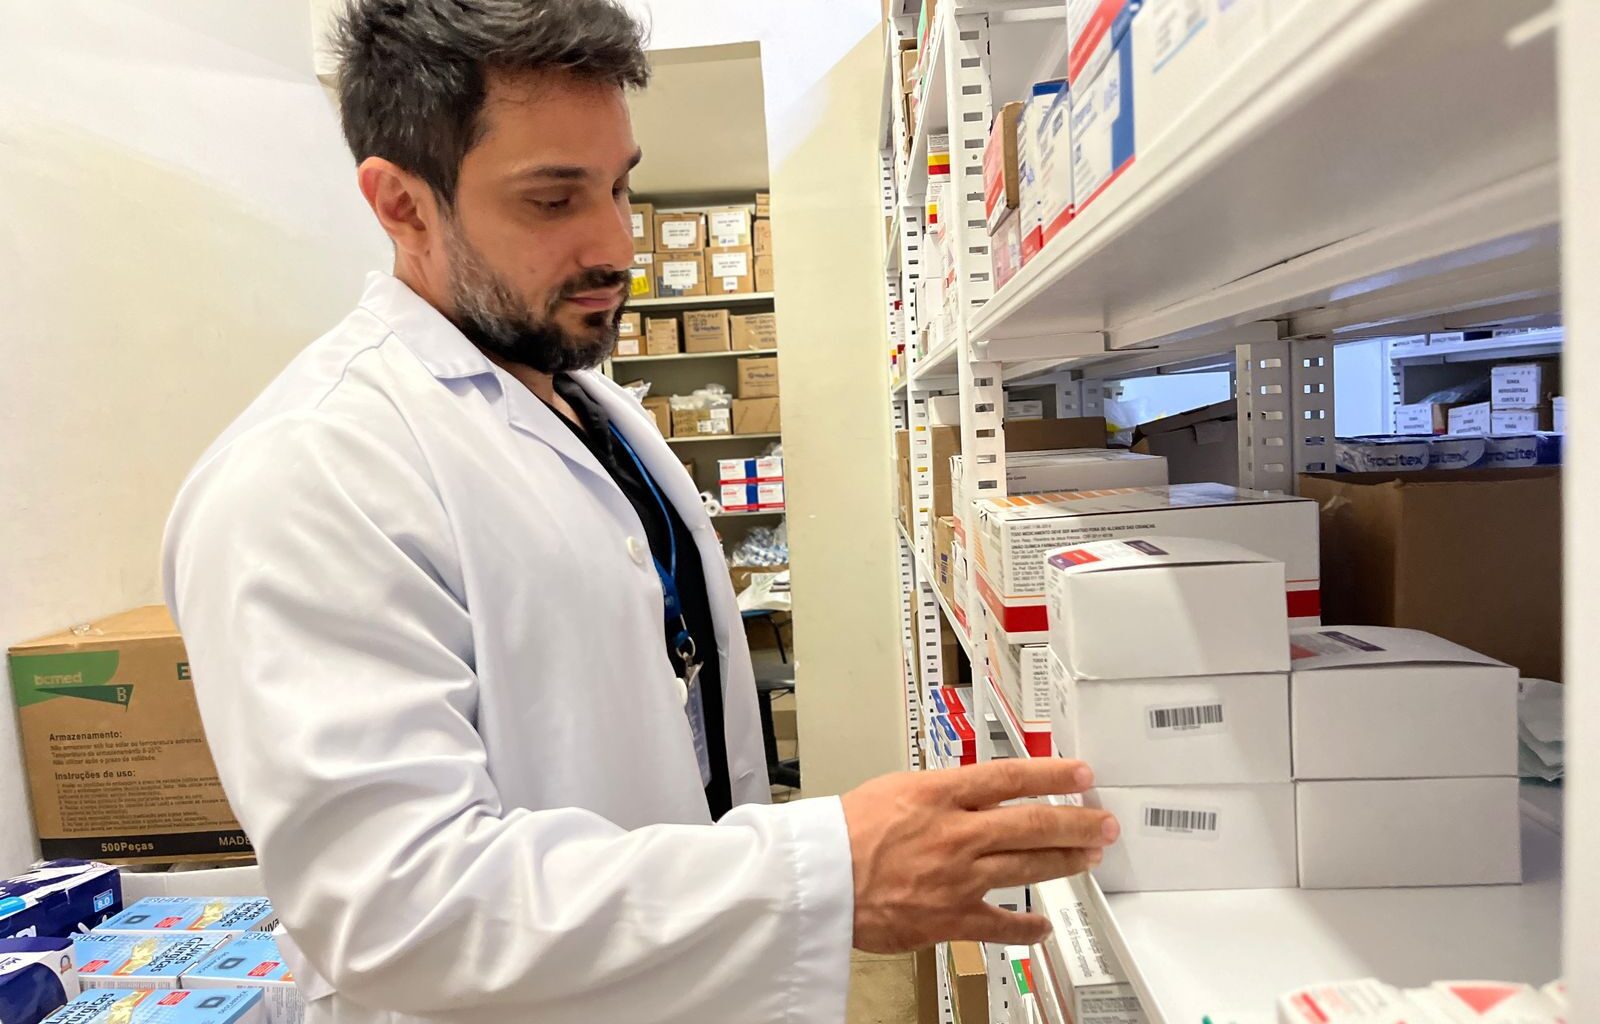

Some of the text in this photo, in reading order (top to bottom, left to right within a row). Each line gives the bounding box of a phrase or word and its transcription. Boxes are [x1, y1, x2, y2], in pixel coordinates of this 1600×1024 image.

[49, 730, 123, 742] Armazenamento:
[55, 769, 136, 781] Instruções de uso:
[101, 841, 155, 854] 500Peças
